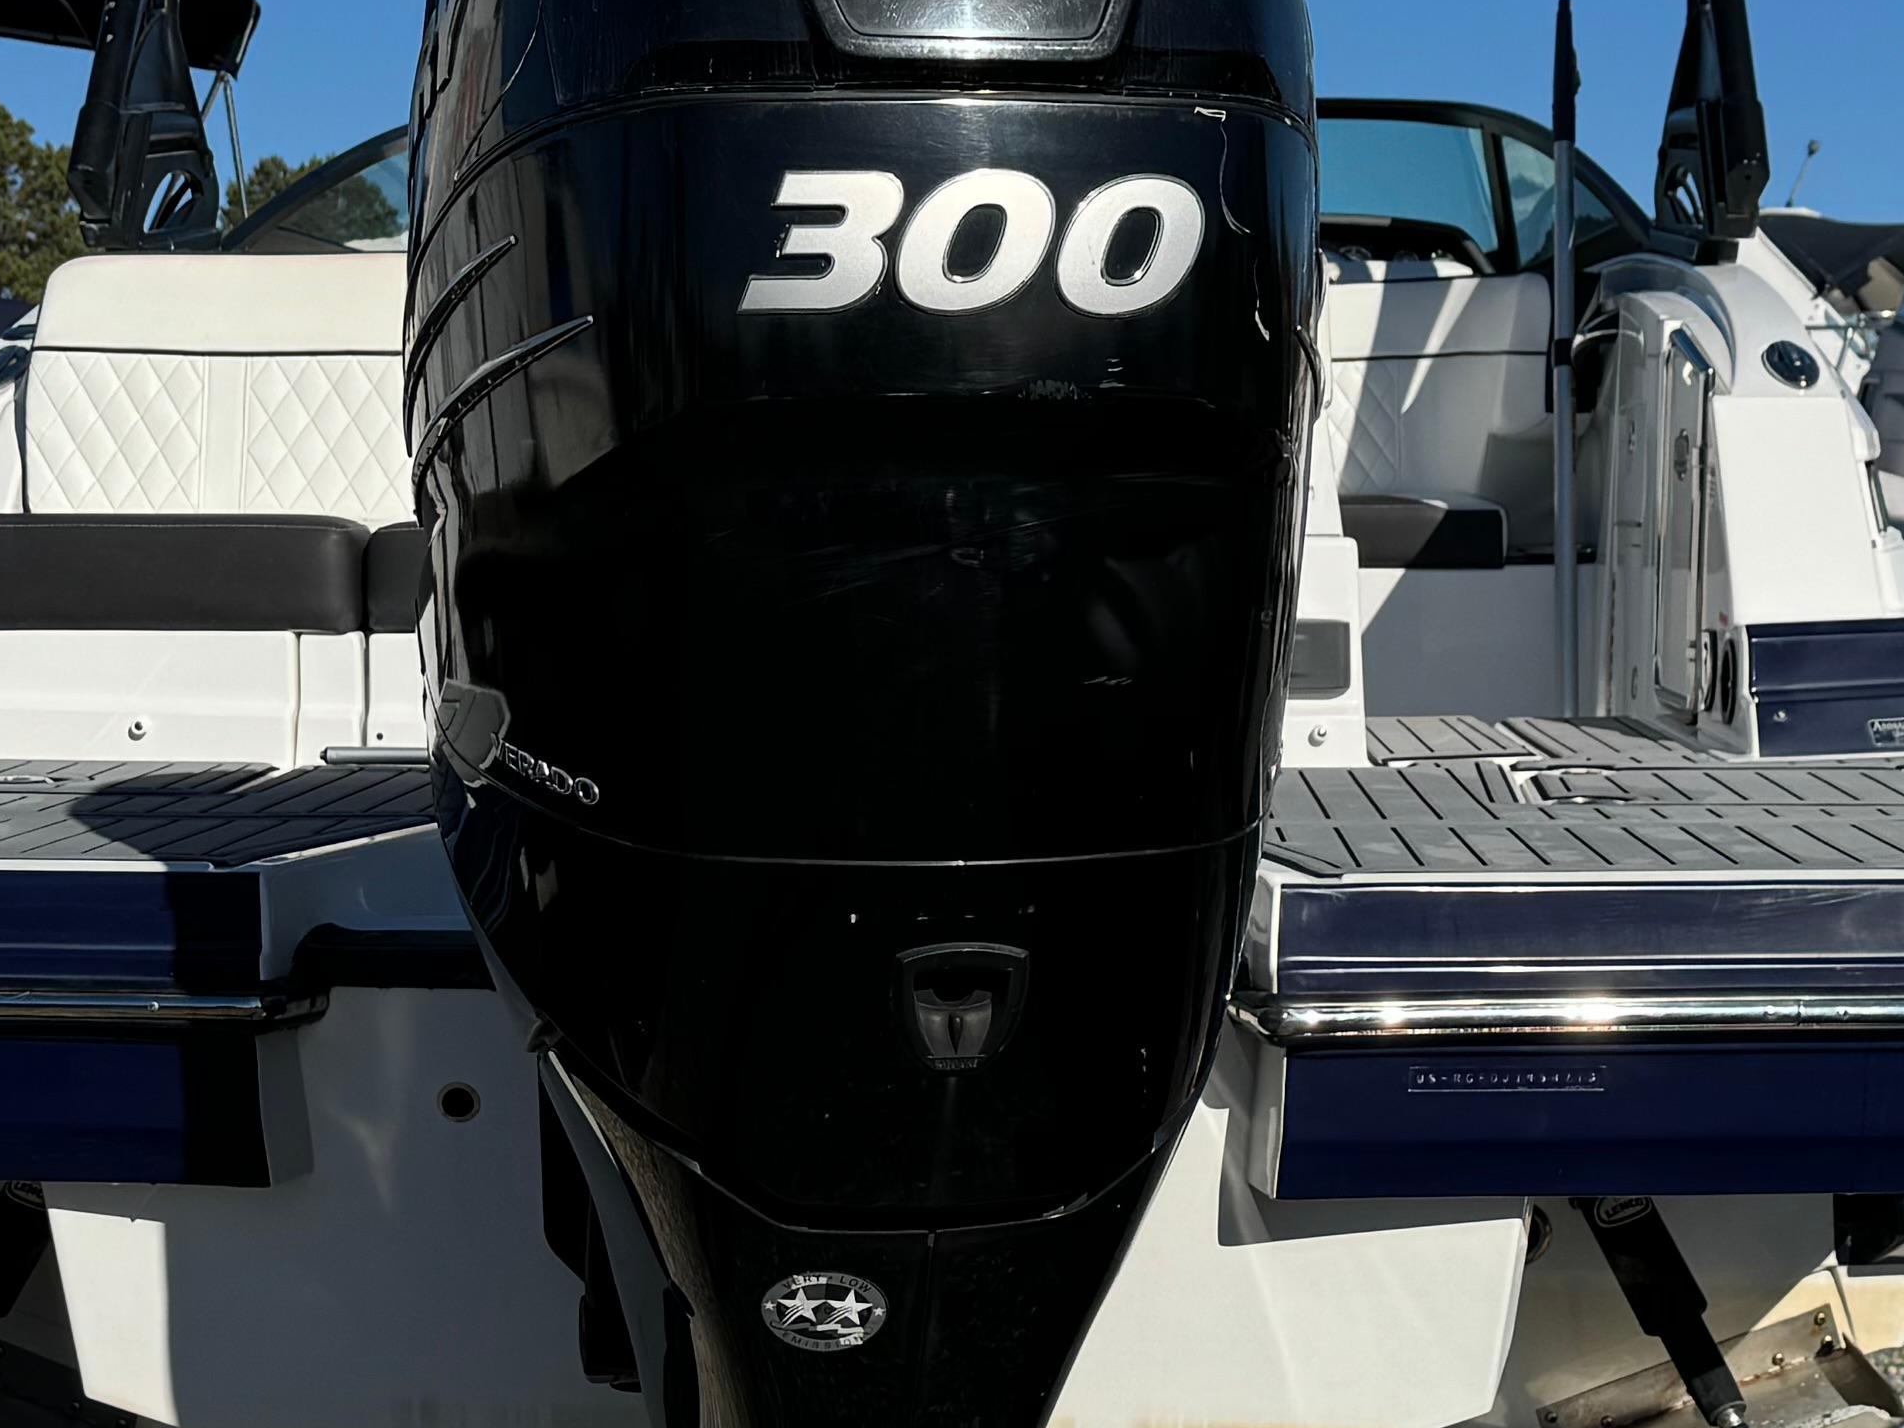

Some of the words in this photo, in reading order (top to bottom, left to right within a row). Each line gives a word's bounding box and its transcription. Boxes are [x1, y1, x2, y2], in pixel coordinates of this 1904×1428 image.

[737, 168, 1206, 318] 300
[490, 732, 599, 804] VERADO
[840, 1276, 872, 1293] LOW
